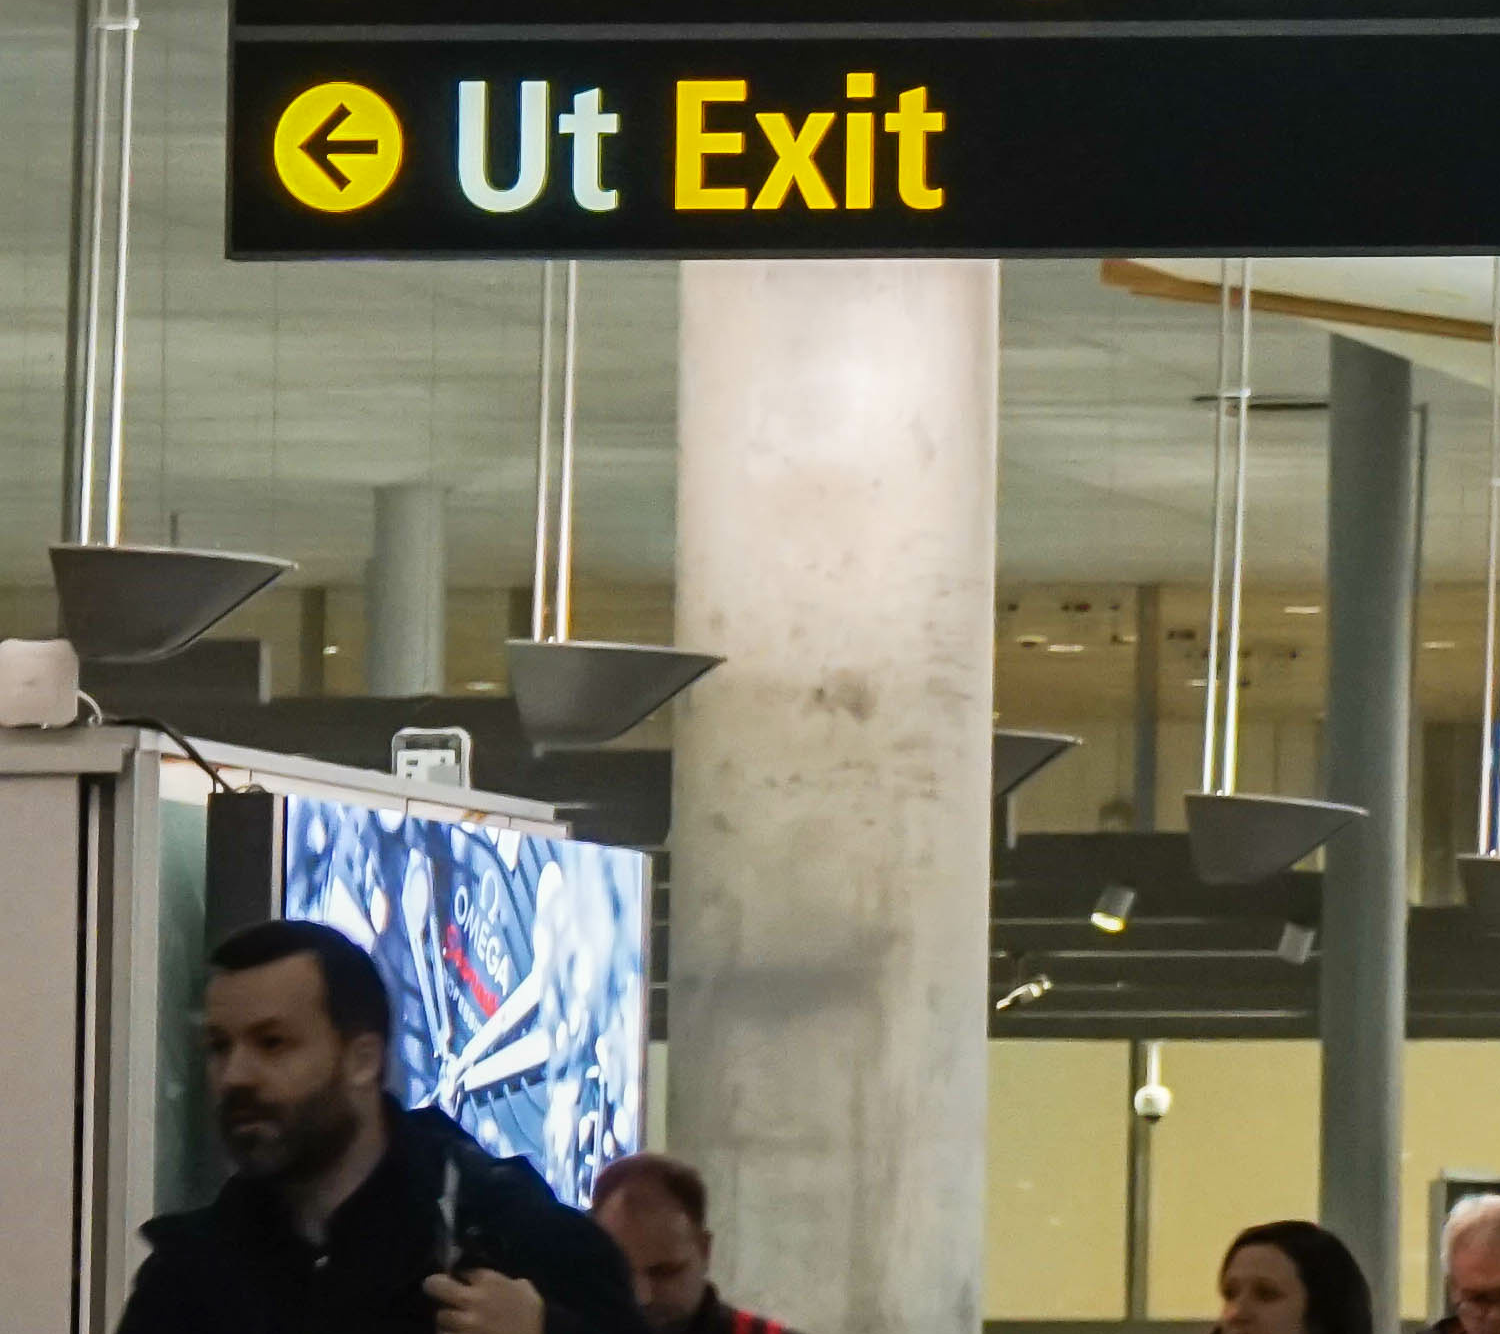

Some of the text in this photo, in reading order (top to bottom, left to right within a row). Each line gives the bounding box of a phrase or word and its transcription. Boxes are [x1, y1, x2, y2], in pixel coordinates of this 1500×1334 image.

[458, 73, 946, 213] Ut Exit
[454, 885, 513, 996] OMEGA
